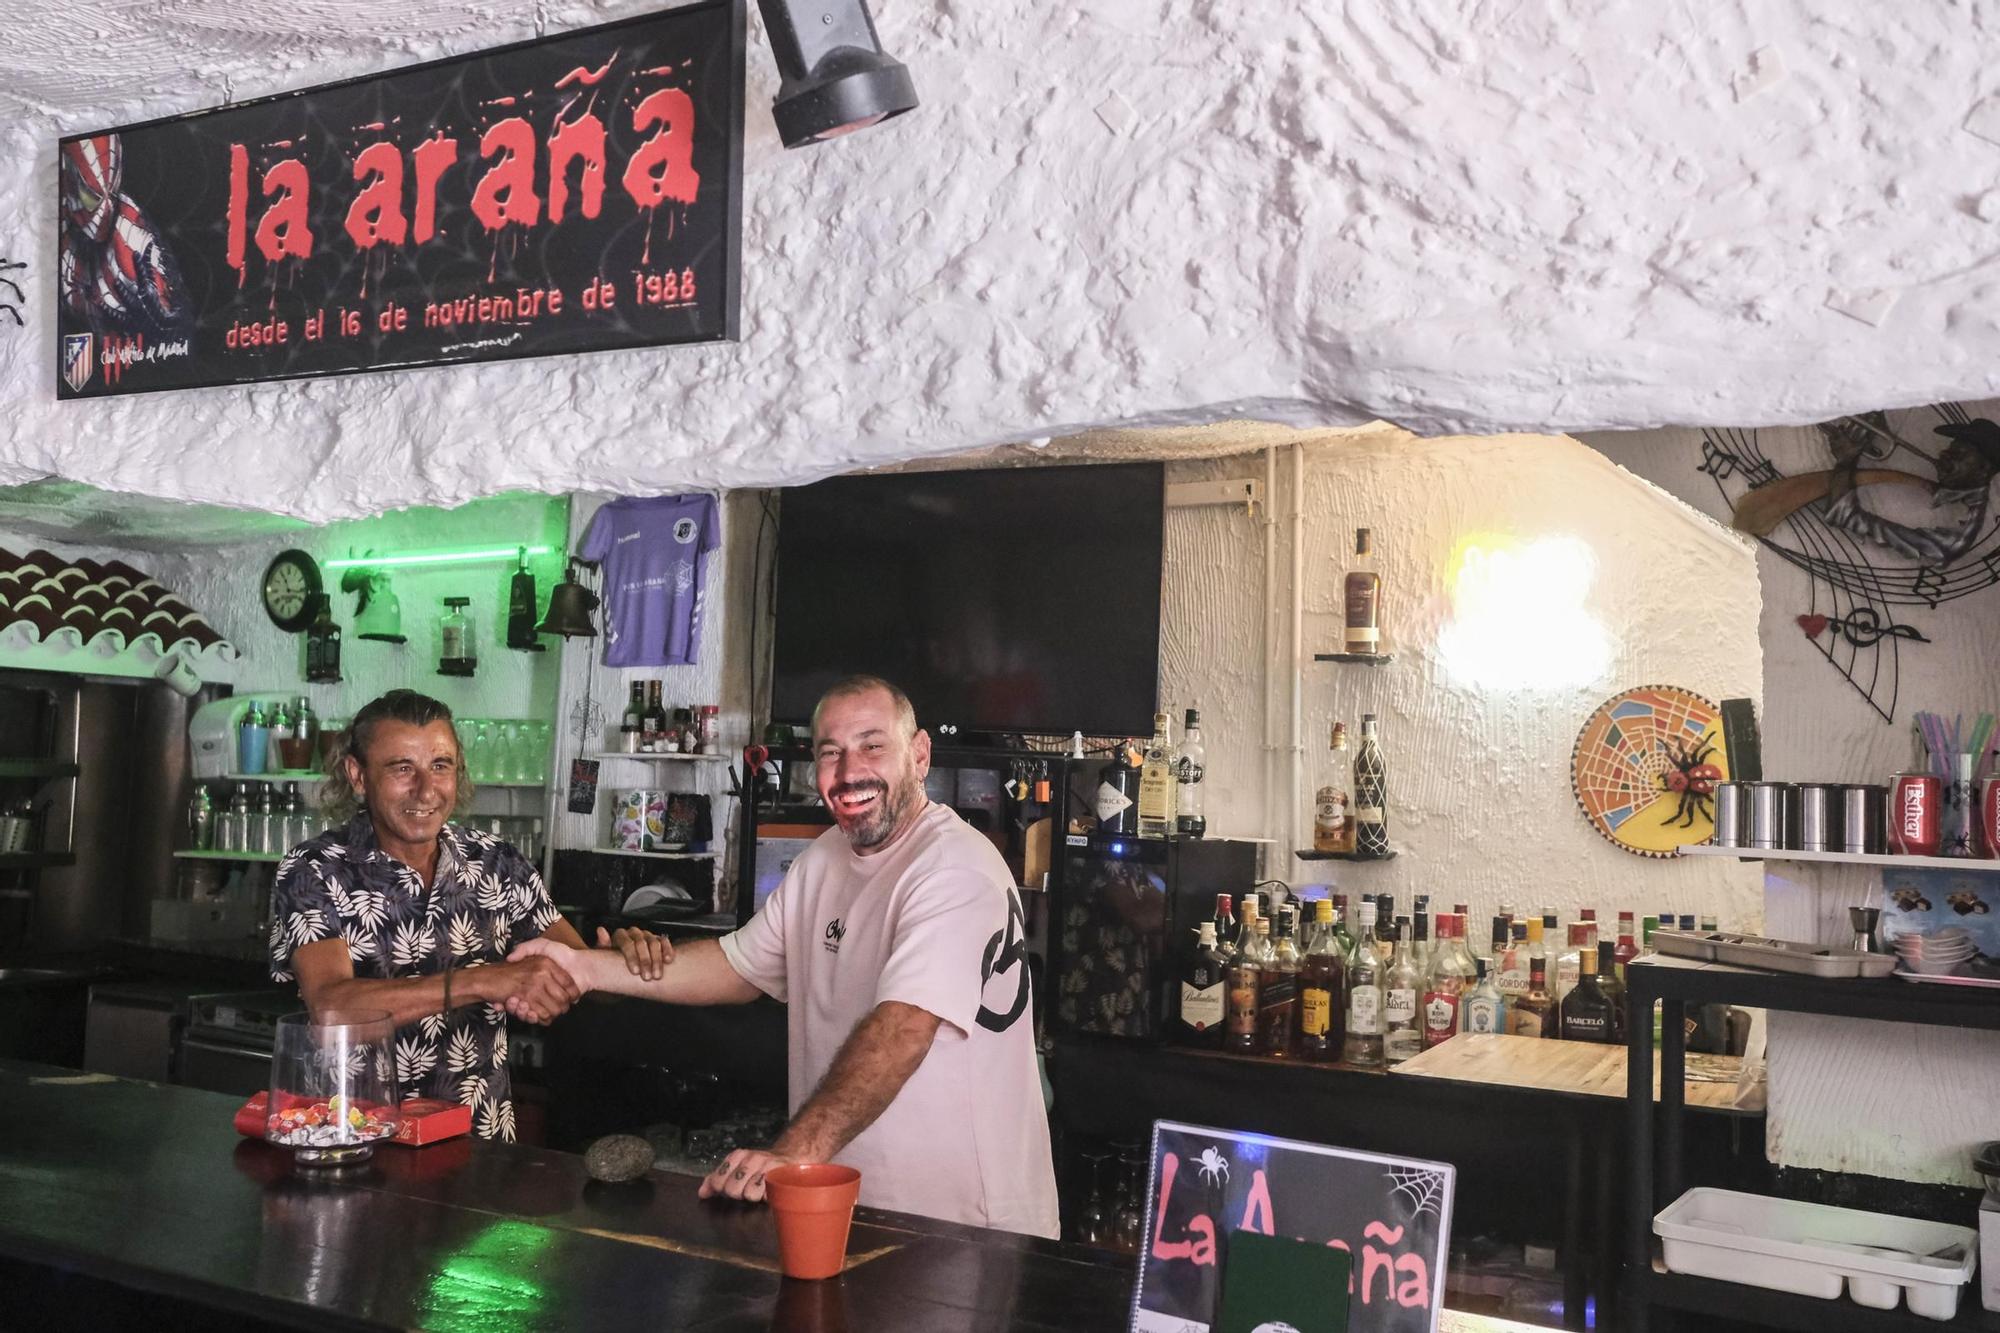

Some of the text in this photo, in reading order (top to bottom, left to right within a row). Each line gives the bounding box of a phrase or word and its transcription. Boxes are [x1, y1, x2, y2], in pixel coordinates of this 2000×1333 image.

[226, 52, 700, 272] la araña
[226, 267, 697, 349] desde el 16 de noviembre de 1988
[1905, 784, 1925, 839] Esther
[1151, 1152, 1429, 1310] La Aña
